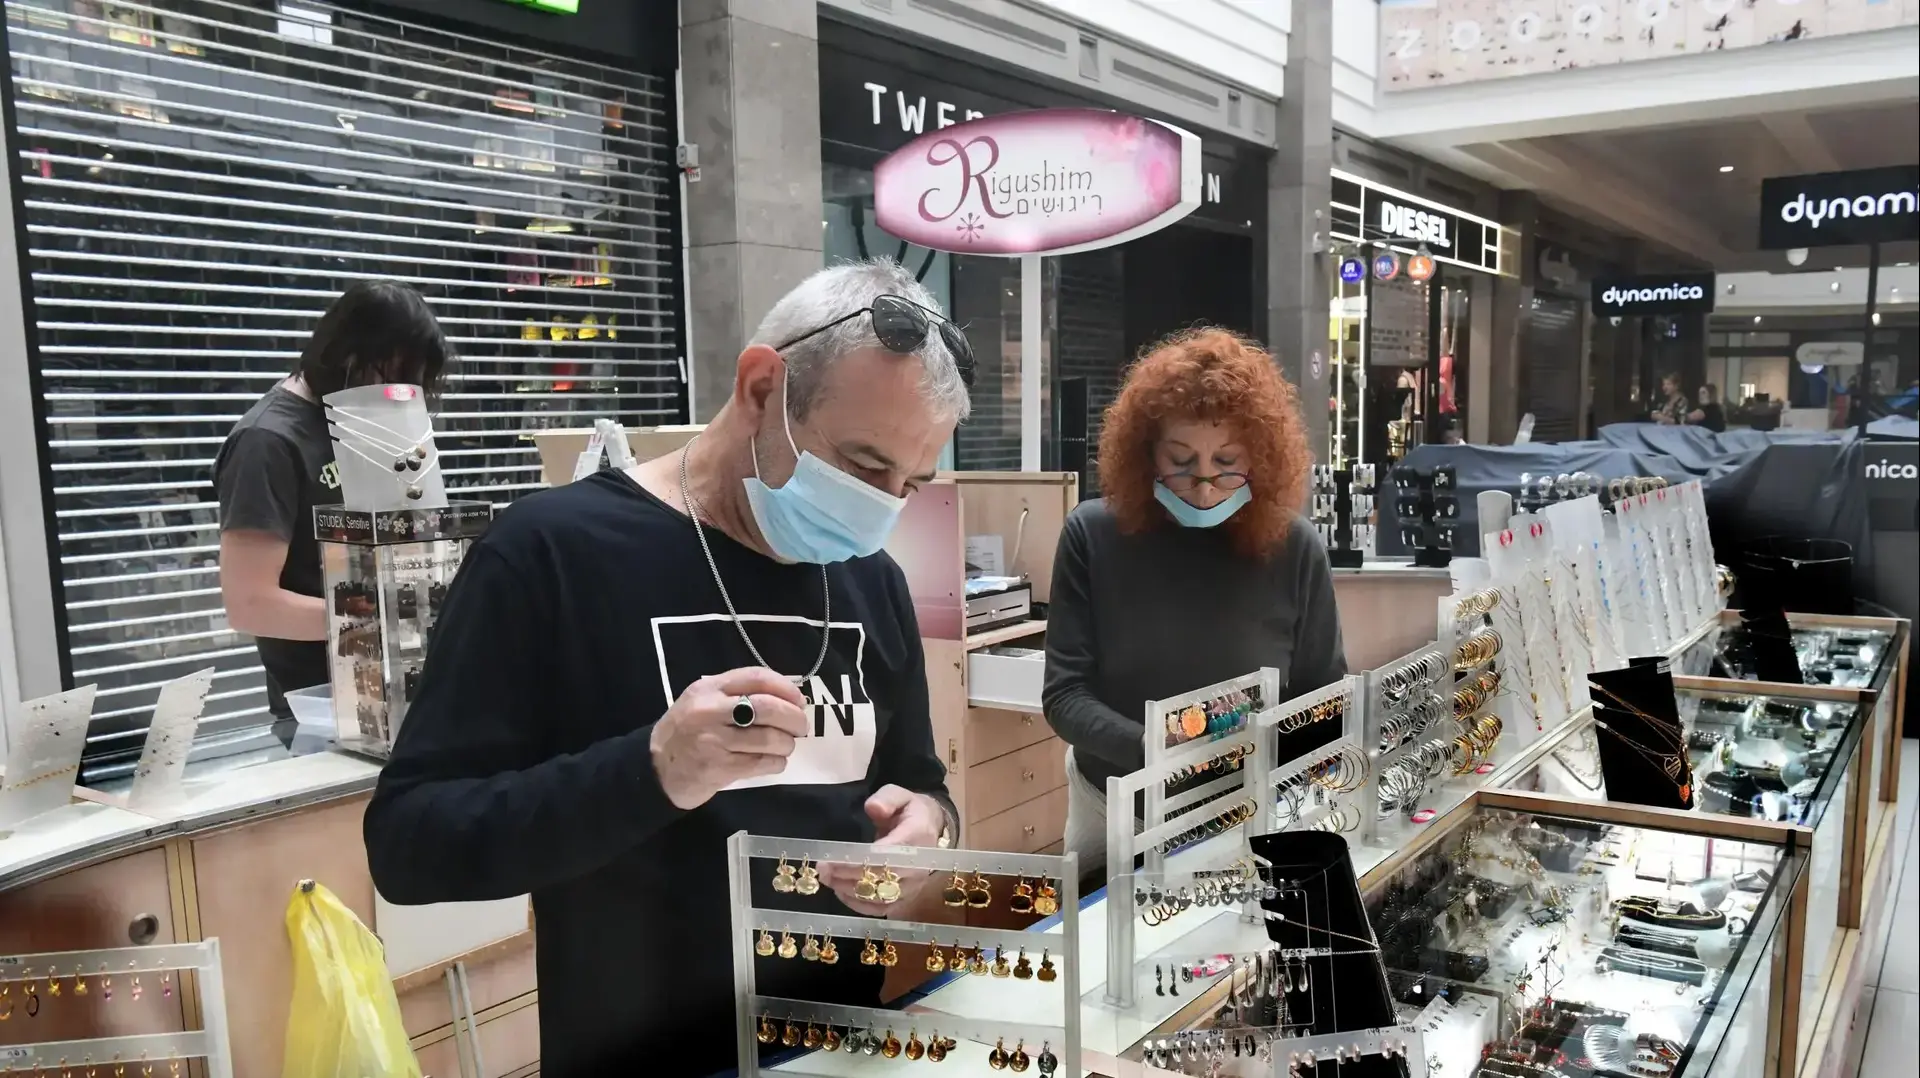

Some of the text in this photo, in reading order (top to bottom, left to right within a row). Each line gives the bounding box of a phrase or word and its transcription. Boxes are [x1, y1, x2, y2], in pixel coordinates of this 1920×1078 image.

[918, 135, 1093, 222] Rigushim
[1381, 201, 1451, 248] DIESEL
[1781, 184, 1919, 228] dynam
[1602, 283, 1703, 307] dynamica
